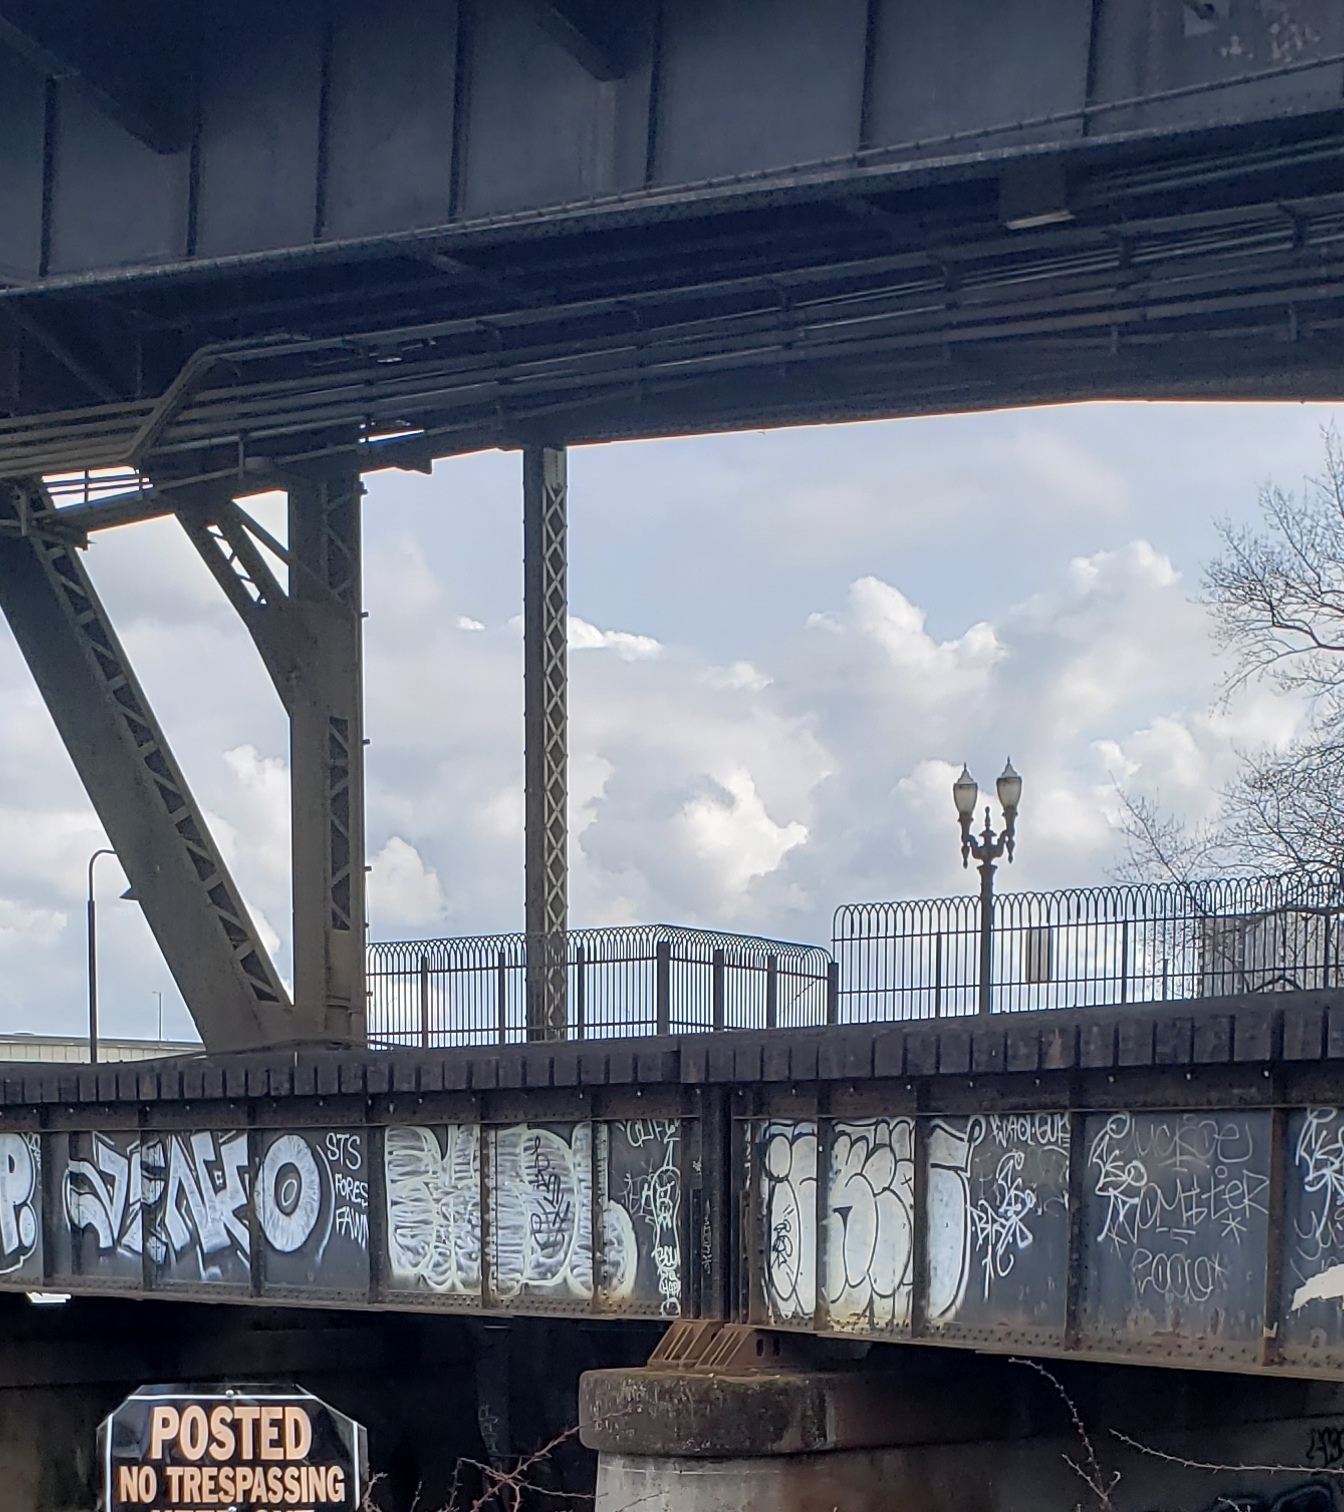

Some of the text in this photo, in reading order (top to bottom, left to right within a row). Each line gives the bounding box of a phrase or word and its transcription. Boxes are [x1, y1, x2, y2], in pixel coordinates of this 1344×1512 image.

[325, 1132, 362, 1170] STS
[150, 1405, 312, 1461] POSTED
[119, 1465, 346, 1504] NO TRESPASSING
